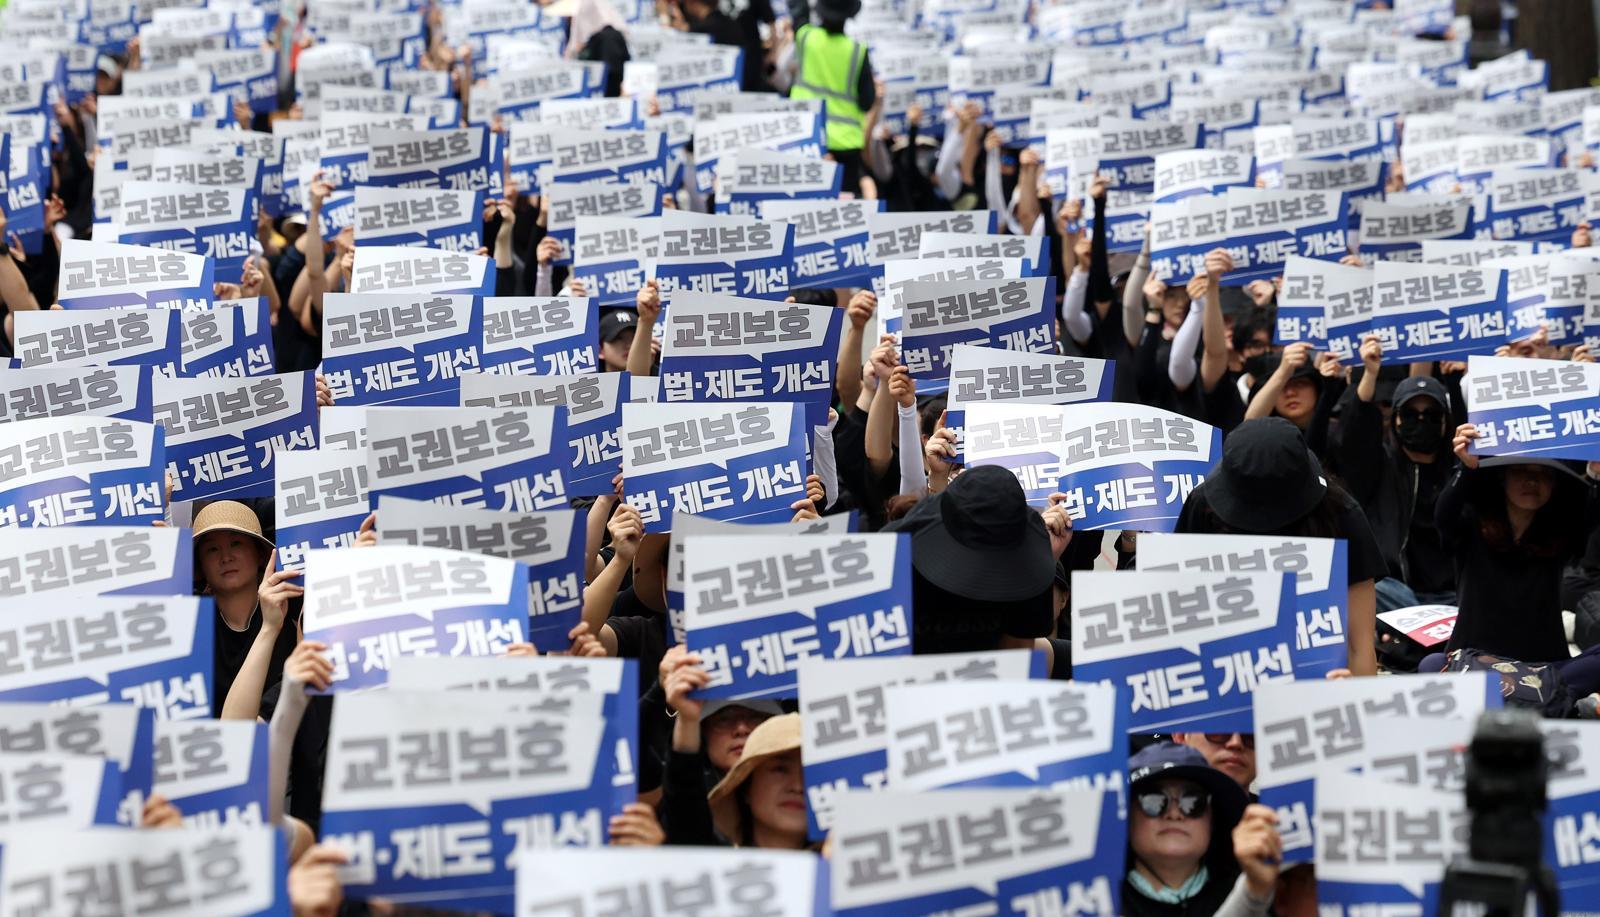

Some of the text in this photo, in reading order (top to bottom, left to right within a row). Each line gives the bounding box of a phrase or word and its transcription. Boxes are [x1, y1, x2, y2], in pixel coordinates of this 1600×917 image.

[372, 131, 472, 169] 교권보호
[557, 133, 648, 167] 교권보호
[722, 114, 803, 149] 교권보호
[1102, 125, 1186, 152] 교권보호
[1295, 121, 1369, 150] 교권보호
[737, 162, 823, 186] 교권보호
[1159, 155, 1240, 190] 교권보호
[1464, 142, 1538, 167] 교권보호
[1285, 165, 1369, 190] 교권보호
[1498, 173, 1580, 203] 교권보호
[125, 189, 232, 226] 교권보호
[358, 193, 462, 231] 교권보호
[553, 188, 645, 223] 교권보호
[780, 203, 866, 237] 권보호
[1230, 193, 1328, 230] 교권보호
[1364, 208, 1456, 238] 교권보호
[201, 231, 249, 259] 개선
[663, 223, 774, 258] 교권보호
[1302, 229, 1346, 258] 개선
[64, 253, 190, 291] 교권보호
[357, 254, 473, 293] 교권보호
[741, 266, 788, 293] 개선
[791, 250, 839, 278] ·제도
[908, 281, 1031, 329] 교권보호
[1377, 270, 1486, 309] 교권보호
[18, 312, 154, 368] 교권보호
[326, 297, 457, 349] 교권보호
[483, 298, 574, 345] 권보호
[672, 306, 812, 349] 교권보호
[1375, 311, 1504, 354] 법·제도 개선
[247, 345, 273, 375] 선
[325, 345, 482, 400] 법·제도 개선
[542, 345, 598, 376] 개선
[663, 360, 831, 401] 법·제도 개선
[954, 360, 1088, 402] 교권보호
[0, 369, 122, 422] 권보호
[1473, 364, 1588, 403] 교권보호
[153, 378, 290, 437] 교권보호
[0, 422, 138, 482] 교권보호
[256, 425, 316, 470] 개선
[372, 410, 535, 479] 교권보호
[568, 426, 621, 468] 개선
[627, 405, 775, 467] 교권보호
[1065, 417, 1199, 466] 교권보호
[1475, 413, 1554, 450] 법·제도
[101, 481, 164, 518] 개선
[280, 464, 368, 518] 교권
[493, 469, 568, 514] 개선
[625, 460, 804, 524] 법·제도 개선
[1061, 473, 1206, 521] 법·제도 개
[0, 531, 156, 596] 교권보호
[692, 540, 874, 615] 교권보호
[312, 557, 492, 619] 교권보호
[828, 606, 911, 659] 개선
[1079, 576, 1260, 650] 교권보호
[0, 602, 172, 676] 교권보호
[446, 617, 525, 657] 개선
[121, 672, 211, 722] 개선
[1126, 643, 1295, 713] 제도 개선
[896, 690, 1094, 778] 교권보호
[339, 721, 569, 793] 교권보호
[842, 797, 1071, 890] 교권보호
[10, 836, 249, 917] 교권보호
